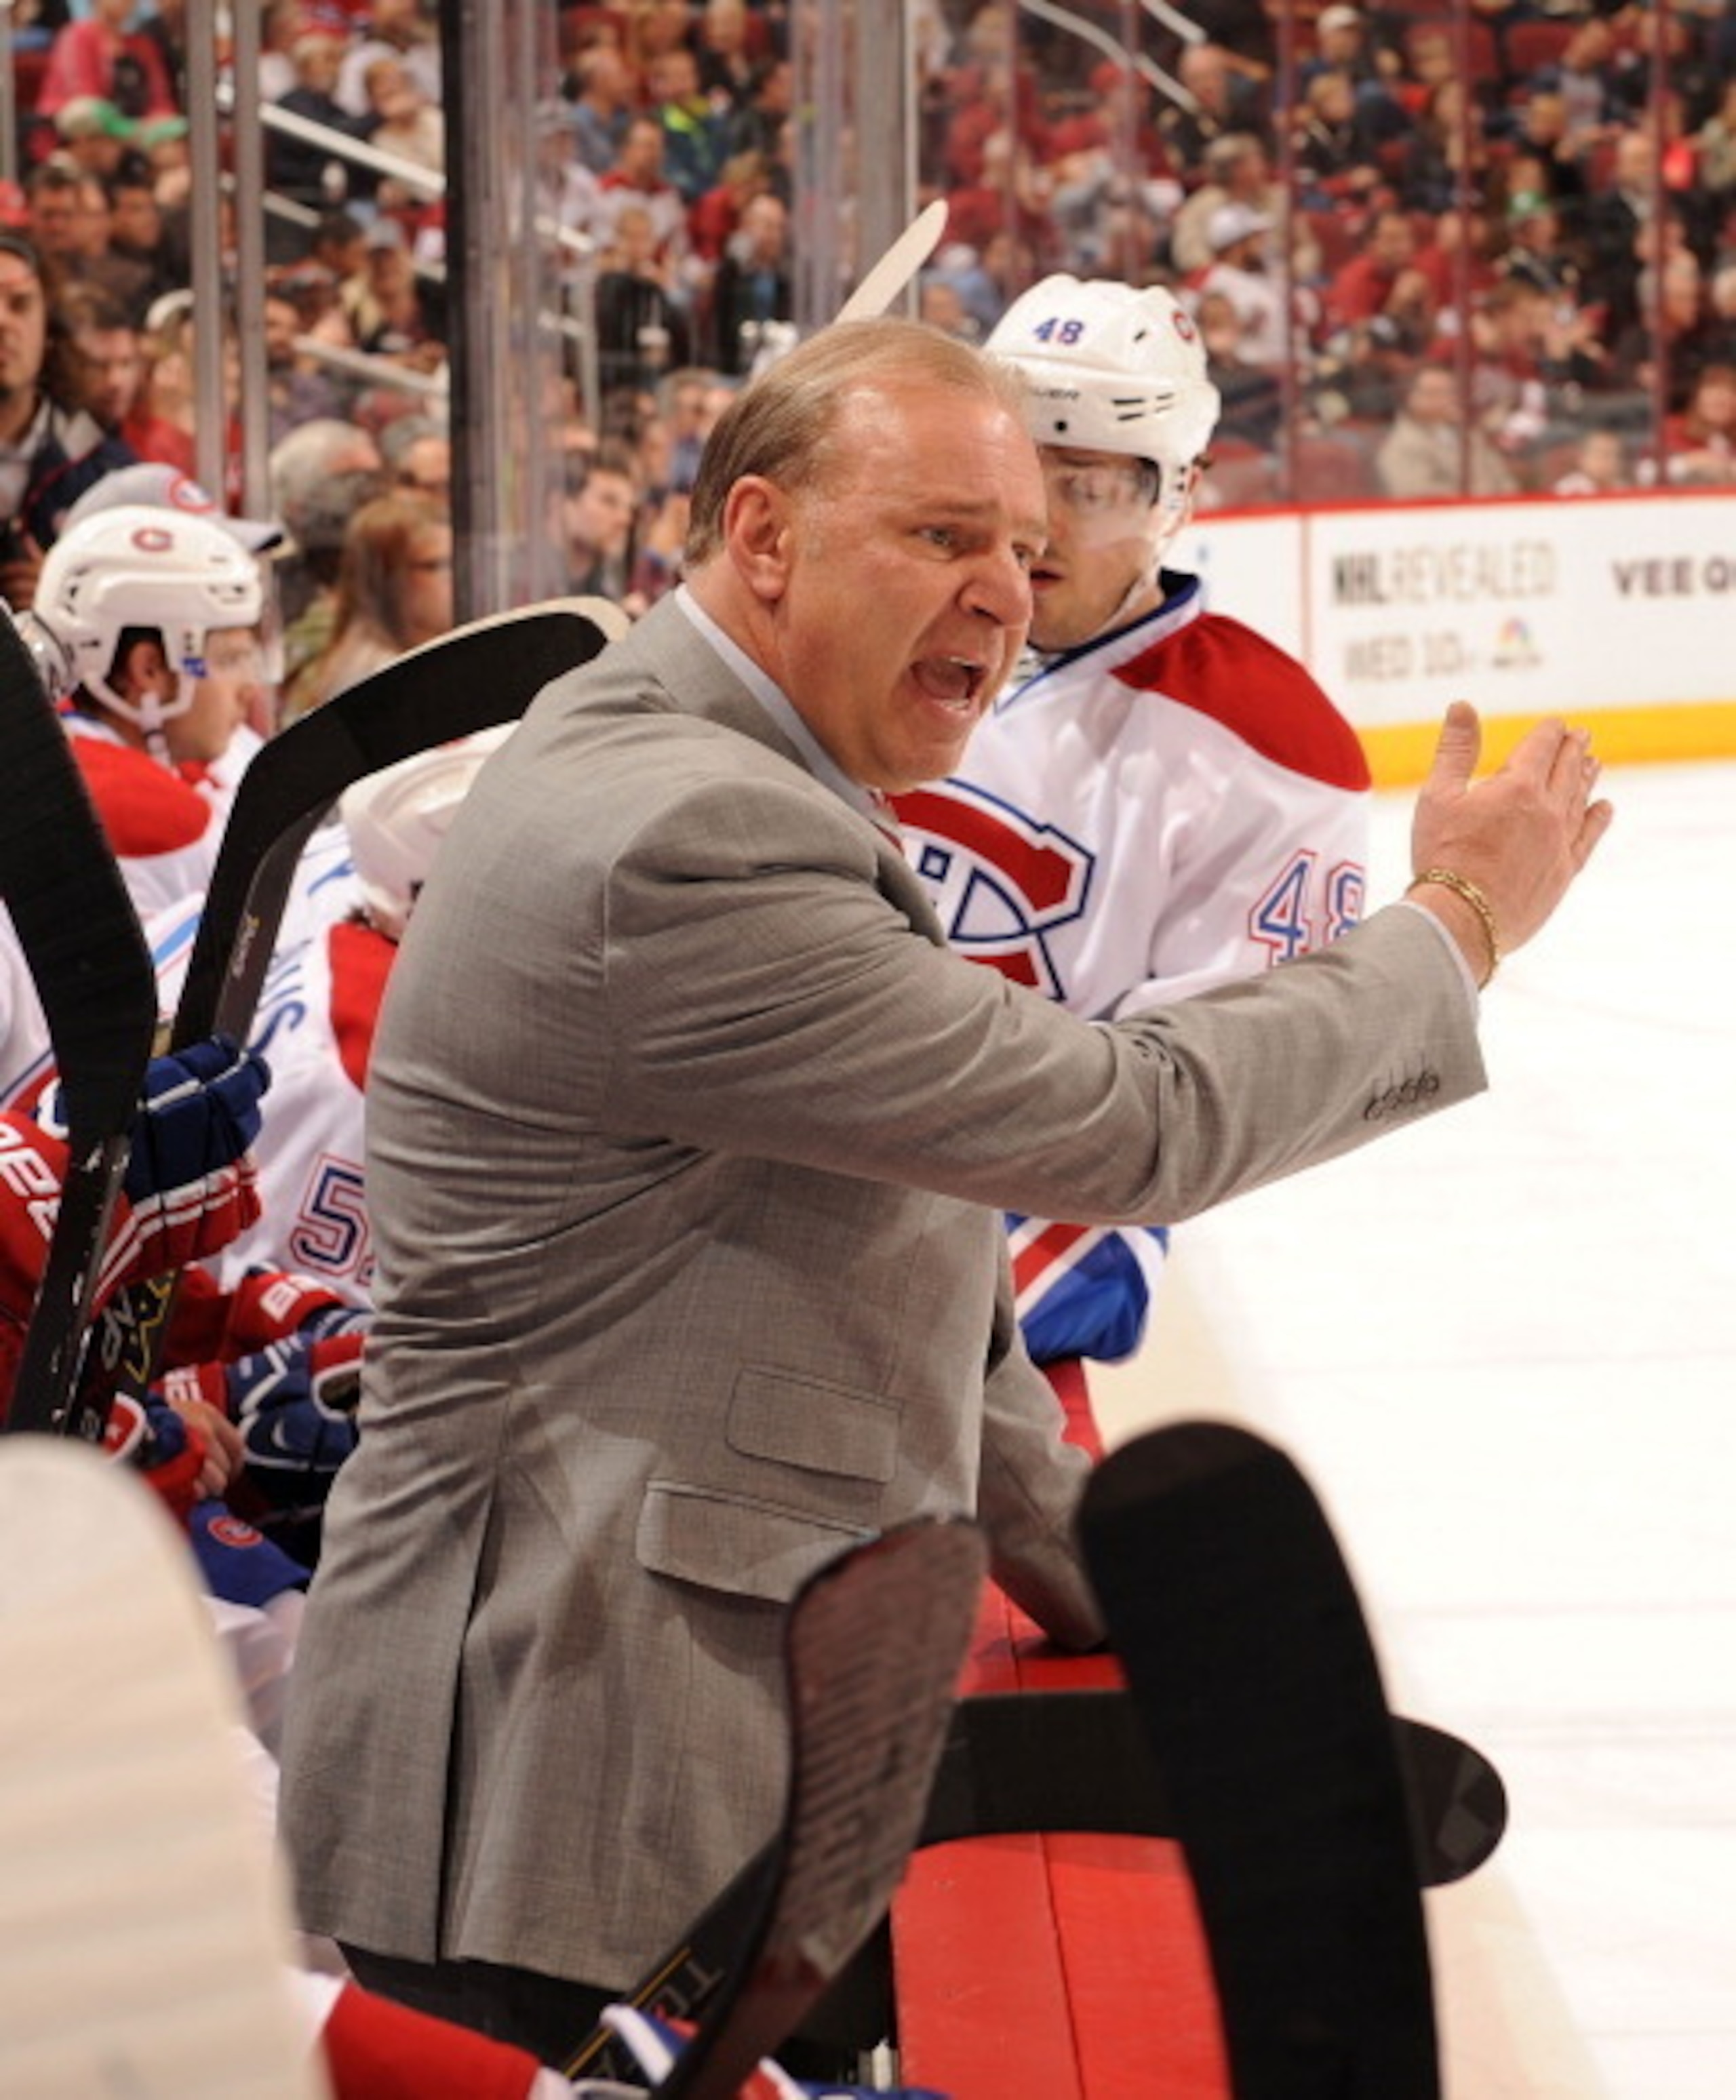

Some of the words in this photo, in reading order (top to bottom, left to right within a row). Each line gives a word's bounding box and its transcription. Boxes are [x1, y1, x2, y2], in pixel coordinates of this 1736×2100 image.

[1033, 317, 1084, 344] 48
[1611, 556, 1695, 598] VEE
[1248, 849, 1366, 970] 48
[289, 1153, 377, 1287] 5
